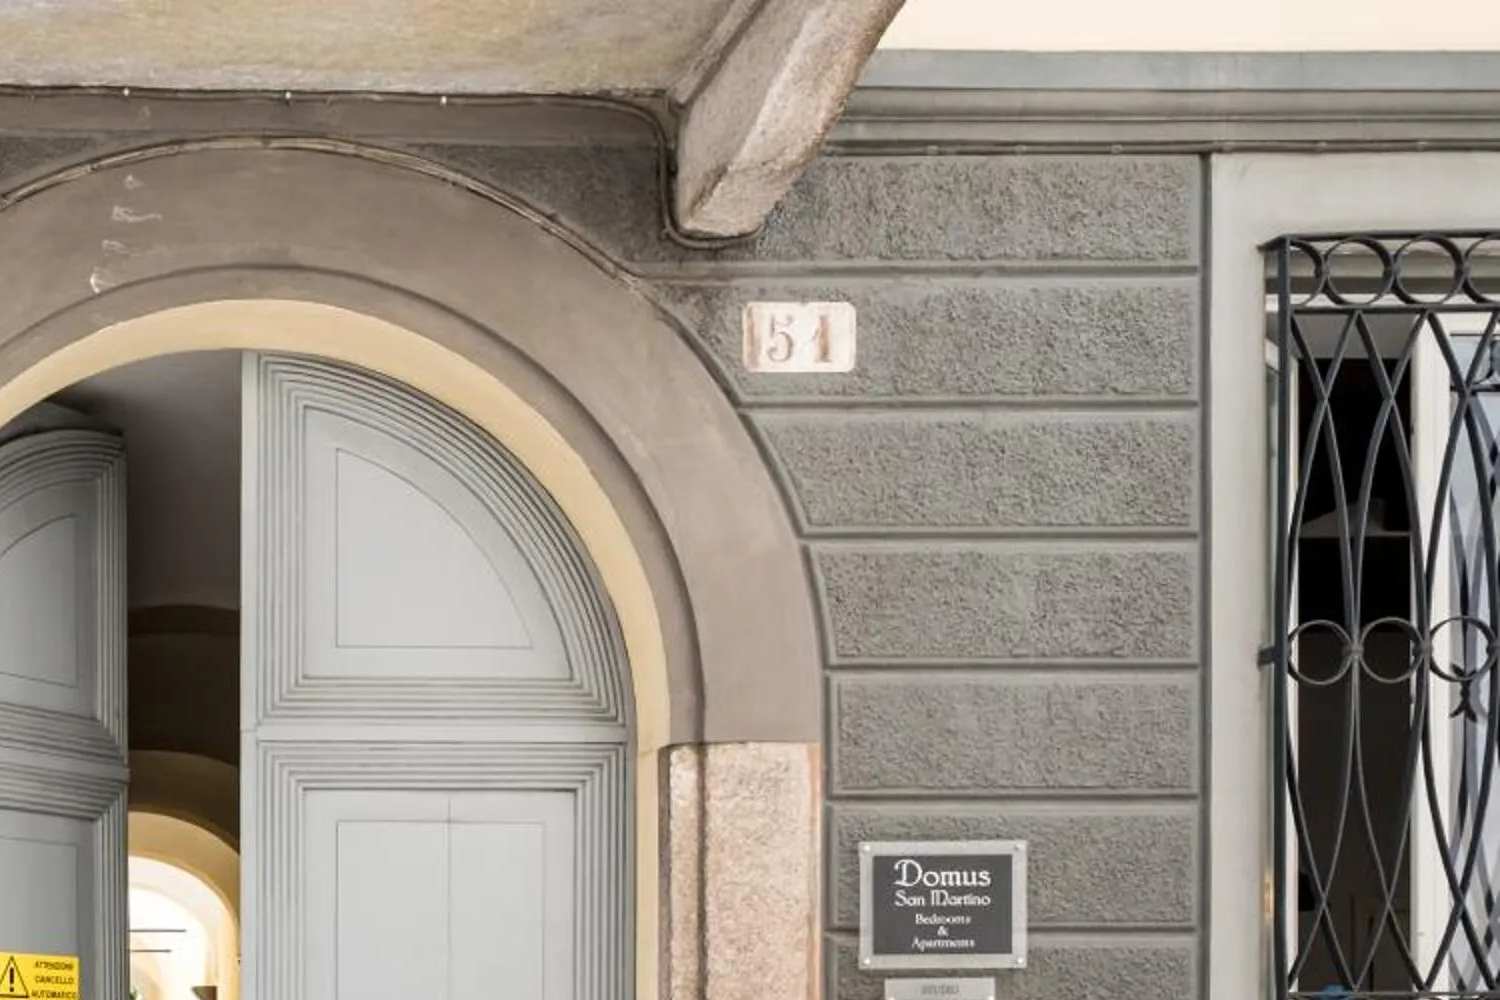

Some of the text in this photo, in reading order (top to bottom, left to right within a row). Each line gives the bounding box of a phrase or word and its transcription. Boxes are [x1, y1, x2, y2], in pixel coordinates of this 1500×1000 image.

[767, 313, 833, 363] 51
[893, 858, 991, 888] Domus
[894, 889, 991, 907] San Martino
[915, 913, 971, 925] Bedrooms
[937, 925, 949, 937] &
[911, 936, 976, 952] Apartments
[34, 974, 75, 985] CANCELLO
[31, 989, 77, 1000] AUTOMATICO
